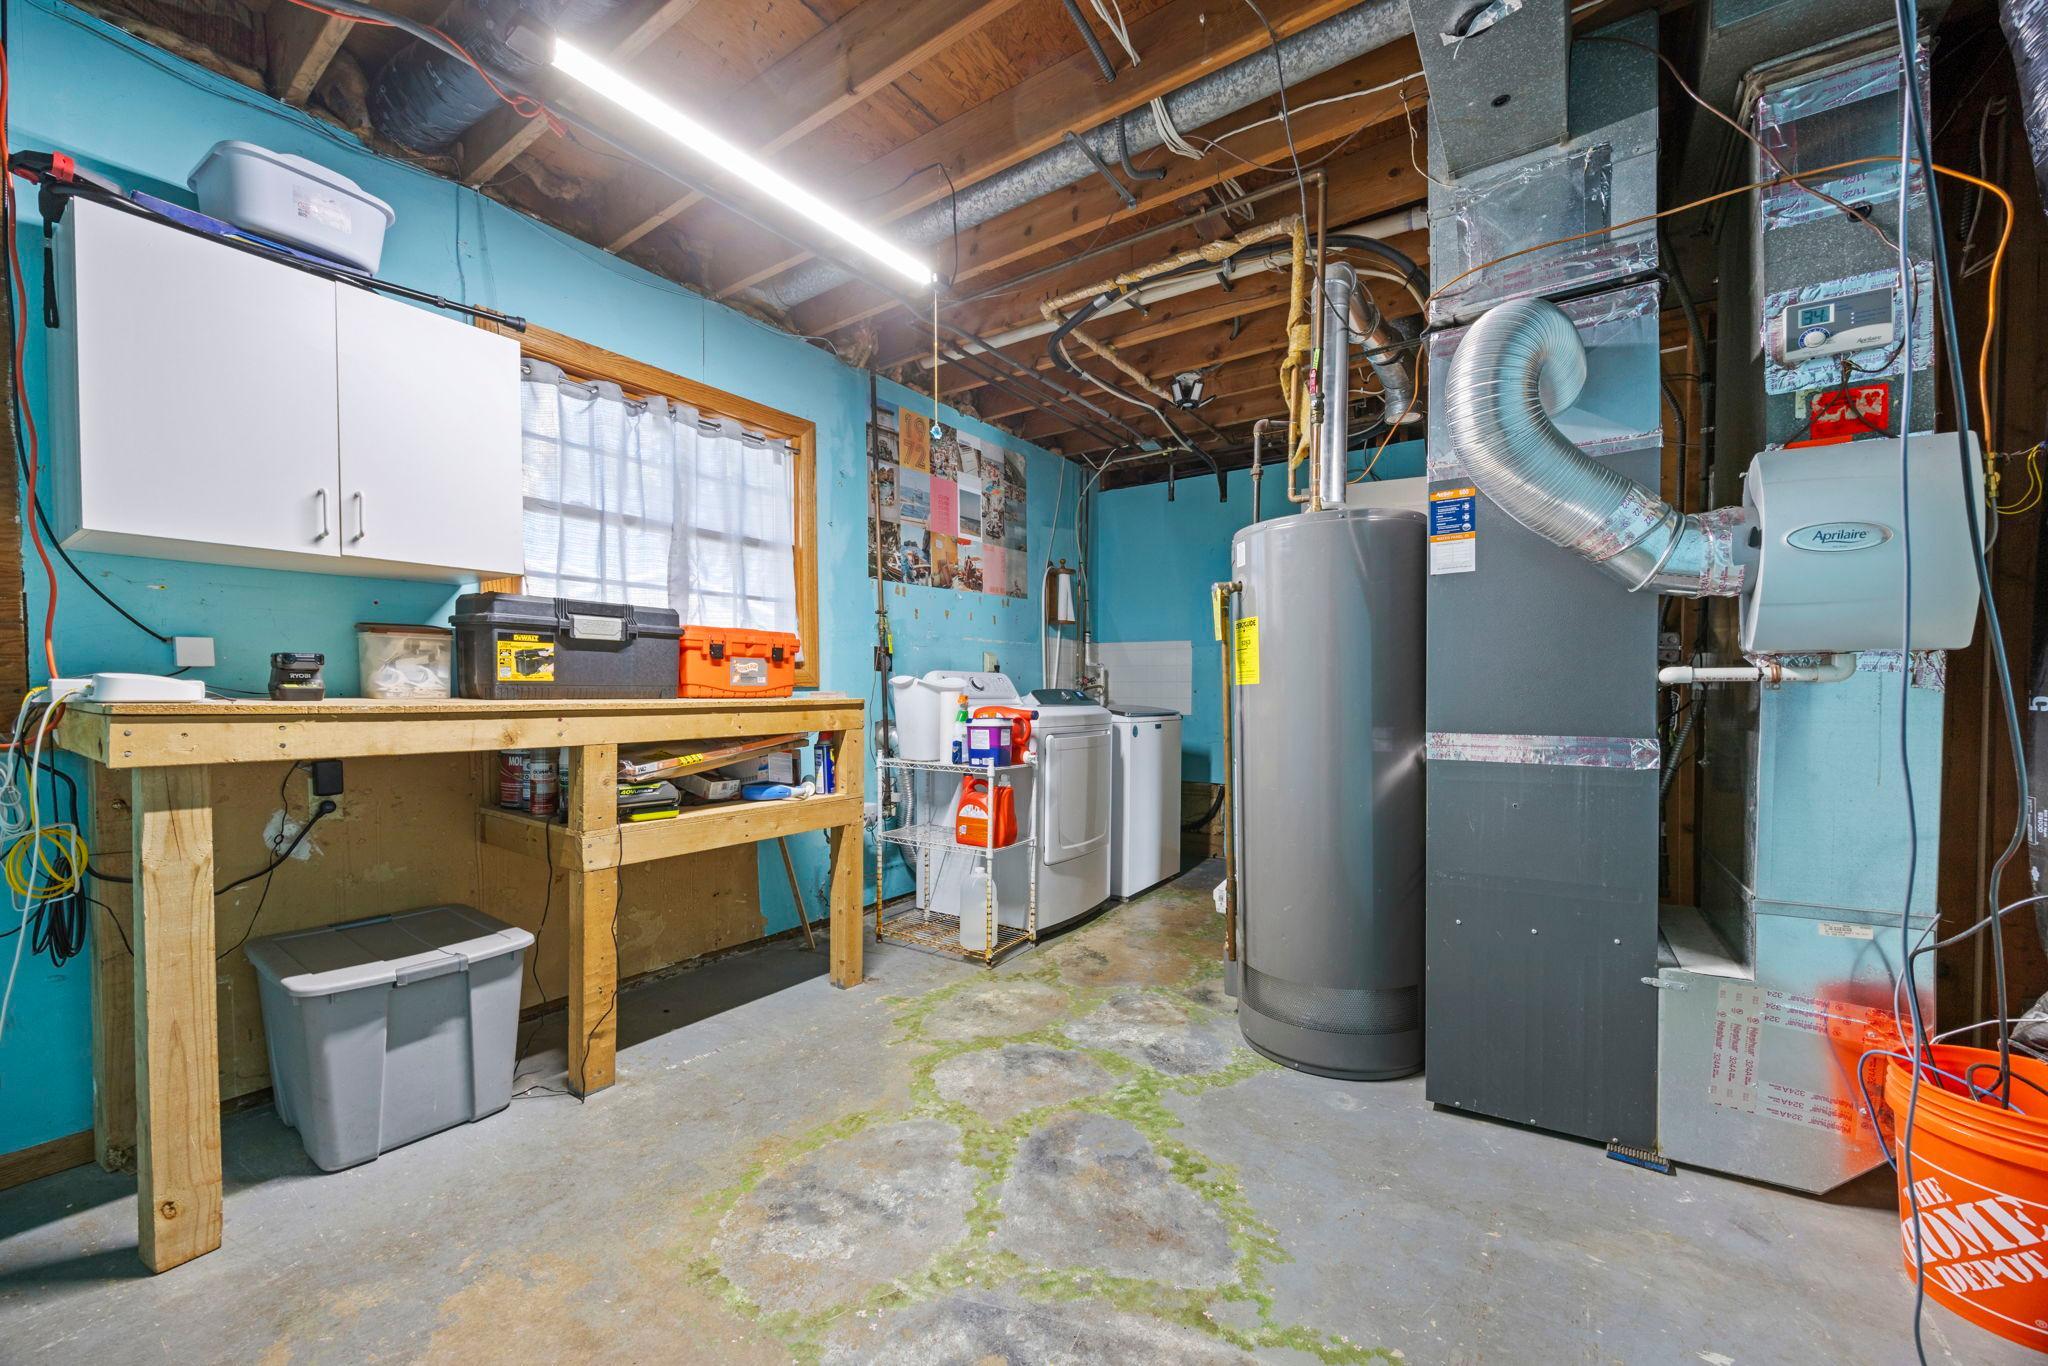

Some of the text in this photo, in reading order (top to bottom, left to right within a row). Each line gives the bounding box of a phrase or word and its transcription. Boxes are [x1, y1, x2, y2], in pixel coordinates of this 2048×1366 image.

[1802, 309, 1824, 326] 34
[1812, 529, 1867, 544] Aprilaire
[1782, 1086, 1806, 1097] 324A
[1781, 1098, 1804, 1109] 324A
[1780, 1110, 1803, 1121] 324A
[1903, 1177, 1953, 1207] THE
[1902, 1198, 2048, 1264] HOME
[1935, 1250, 2048, 1294] DEPOT
